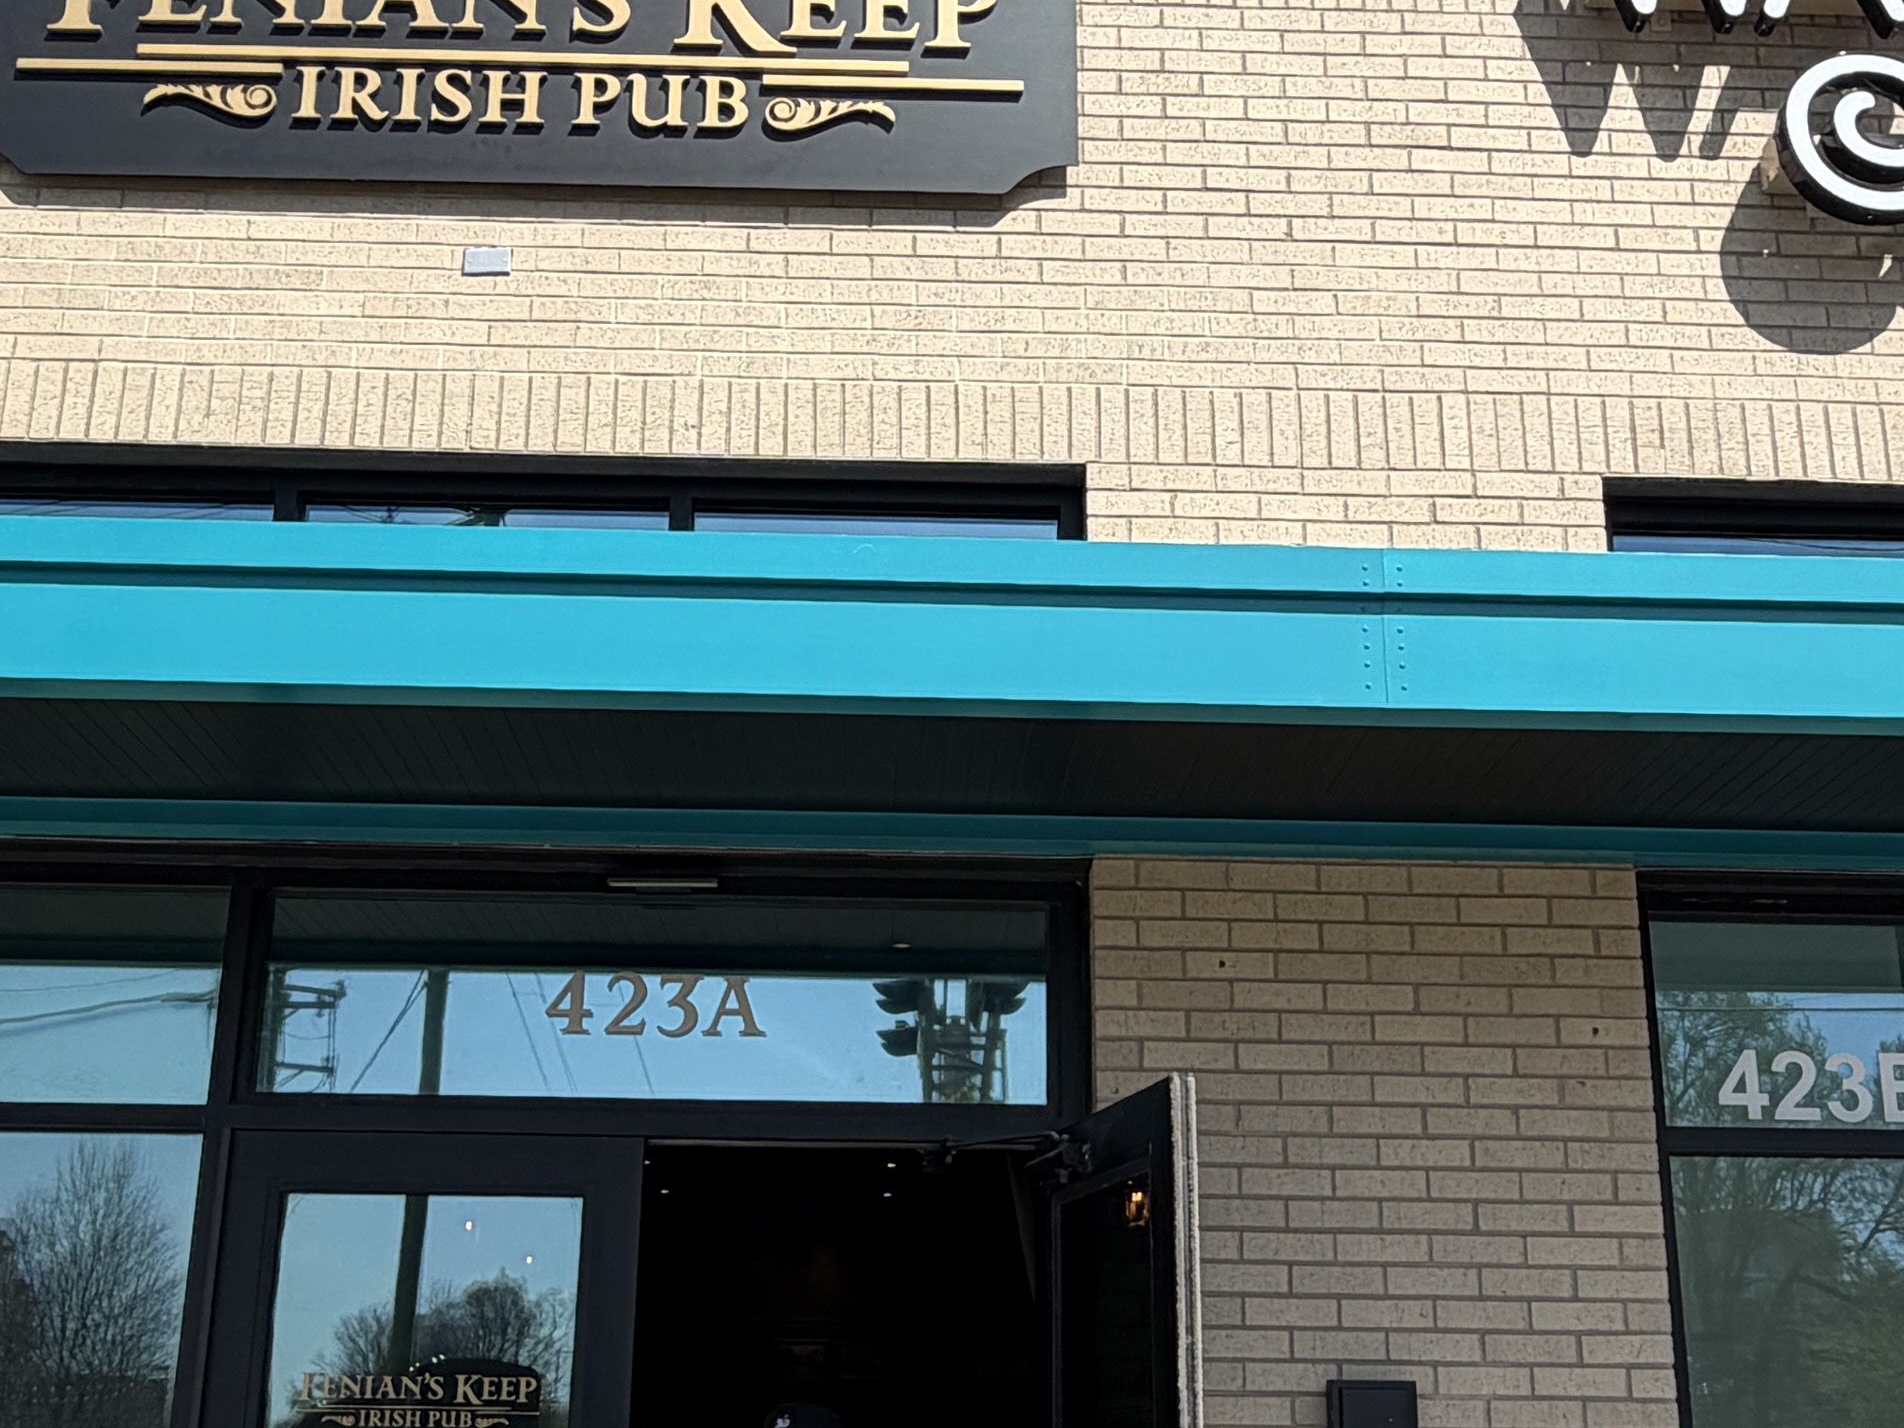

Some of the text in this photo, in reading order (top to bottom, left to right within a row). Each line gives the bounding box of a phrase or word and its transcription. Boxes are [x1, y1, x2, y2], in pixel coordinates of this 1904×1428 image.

[290, 64, 752, 134] IRISH PUB
[543, 972, 768, 1038] 423A
[299, 1371, 539, 1405] FENIAN'S KEEP
[357, 1409, 422, 1428] IRISH
